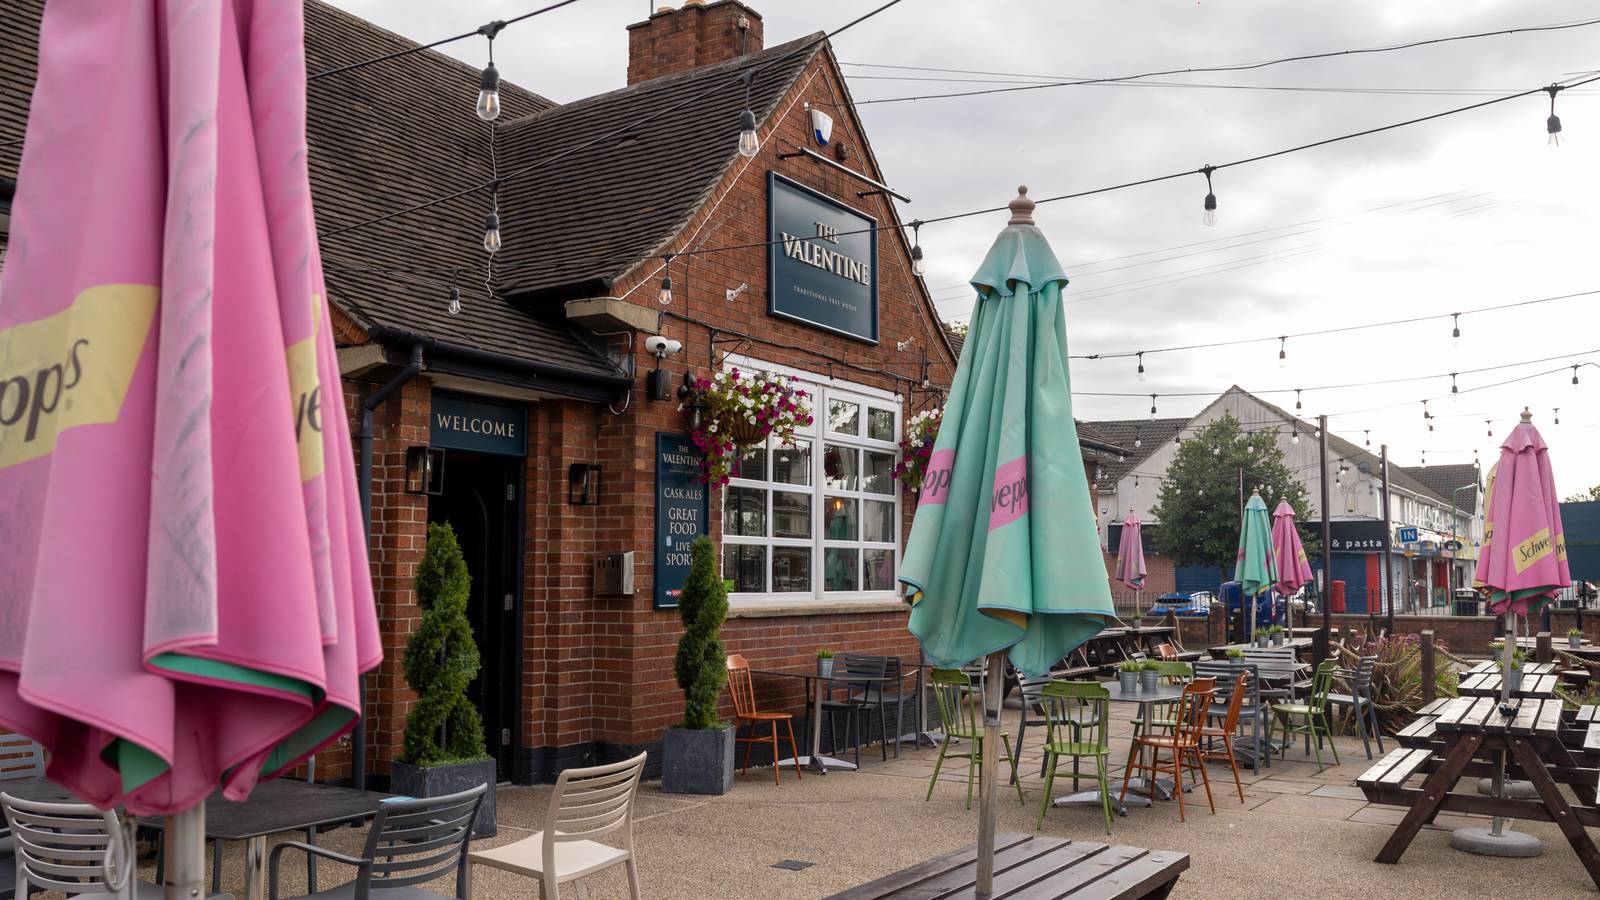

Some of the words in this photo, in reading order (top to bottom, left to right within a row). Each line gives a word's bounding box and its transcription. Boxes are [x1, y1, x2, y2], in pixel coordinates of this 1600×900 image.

[815, 221, 840, 244] THE
[780, 231, 870, 286] VALENTINE
[437, 413, 515, 438] WELCOME
[678, 445, 689, 453] THE
[662, 452, 703, 467] VALENTIN
[664, 487, 684, 499] CASK
[685, 489, 703, 501] ALES
[668, 507, 698, 521] GREAT
[669, 521, 697, 535] FOOD
[675, 541, 691, 552] LIVE
[1332, 539, 1340, 548] &
[1346, 539, 1382, 549] pasta
[666, 552, 693, 566] SPORT
